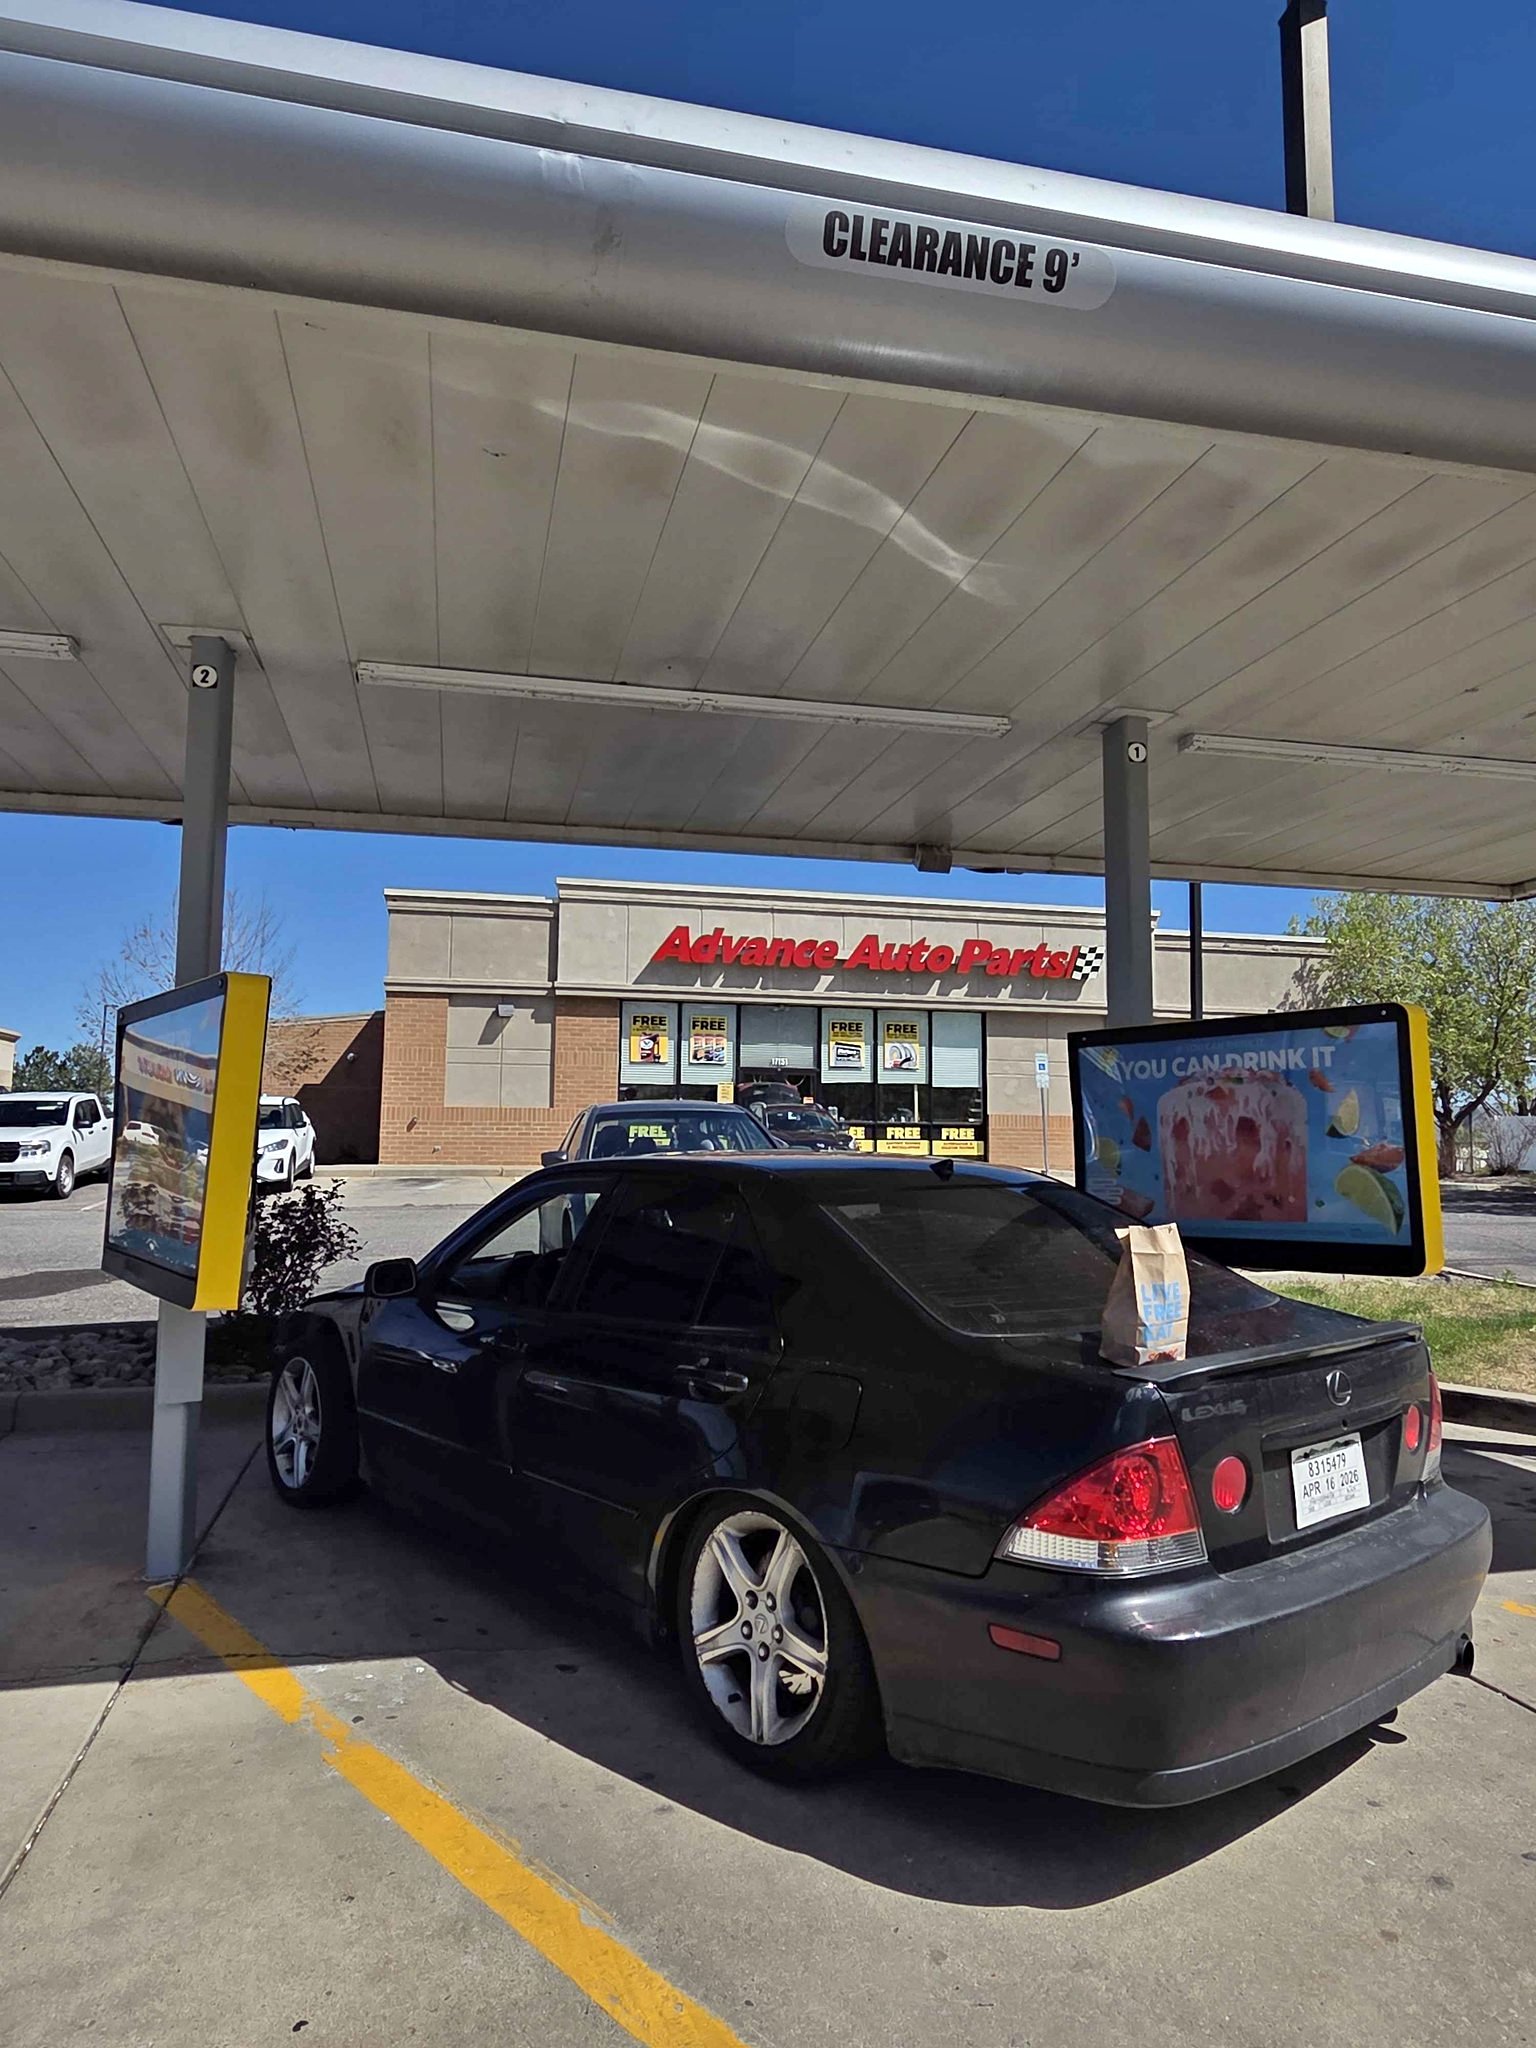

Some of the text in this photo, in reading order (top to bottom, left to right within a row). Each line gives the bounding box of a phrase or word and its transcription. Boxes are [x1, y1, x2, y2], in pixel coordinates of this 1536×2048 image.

[822, 210, 1036, 289] CLEARANCE
[200, 669, 210, 683] 2
[651, 925, 1070, 980] Advance Auto Parts
[632, 1015, 667, 1026] FREE
[692, 1020, 726, 1031] FREE
[831, 1021, 863, 1032] FREE
[886, 1023, 918, 1034] FREE
[1121, 1046, 1336, 1081] YOU CAN DRINK IT
[886, 1126, 921, 1139] FREE
[941, 1127, 975, 1140] FREE
[1308, 1452, 1346, 1478] 8315479
[1303, 1480, 1321, 1499] APR
[1326, 1476, 1335, 1490] 16
[1340, 1469, 1359, 1487] 2026
